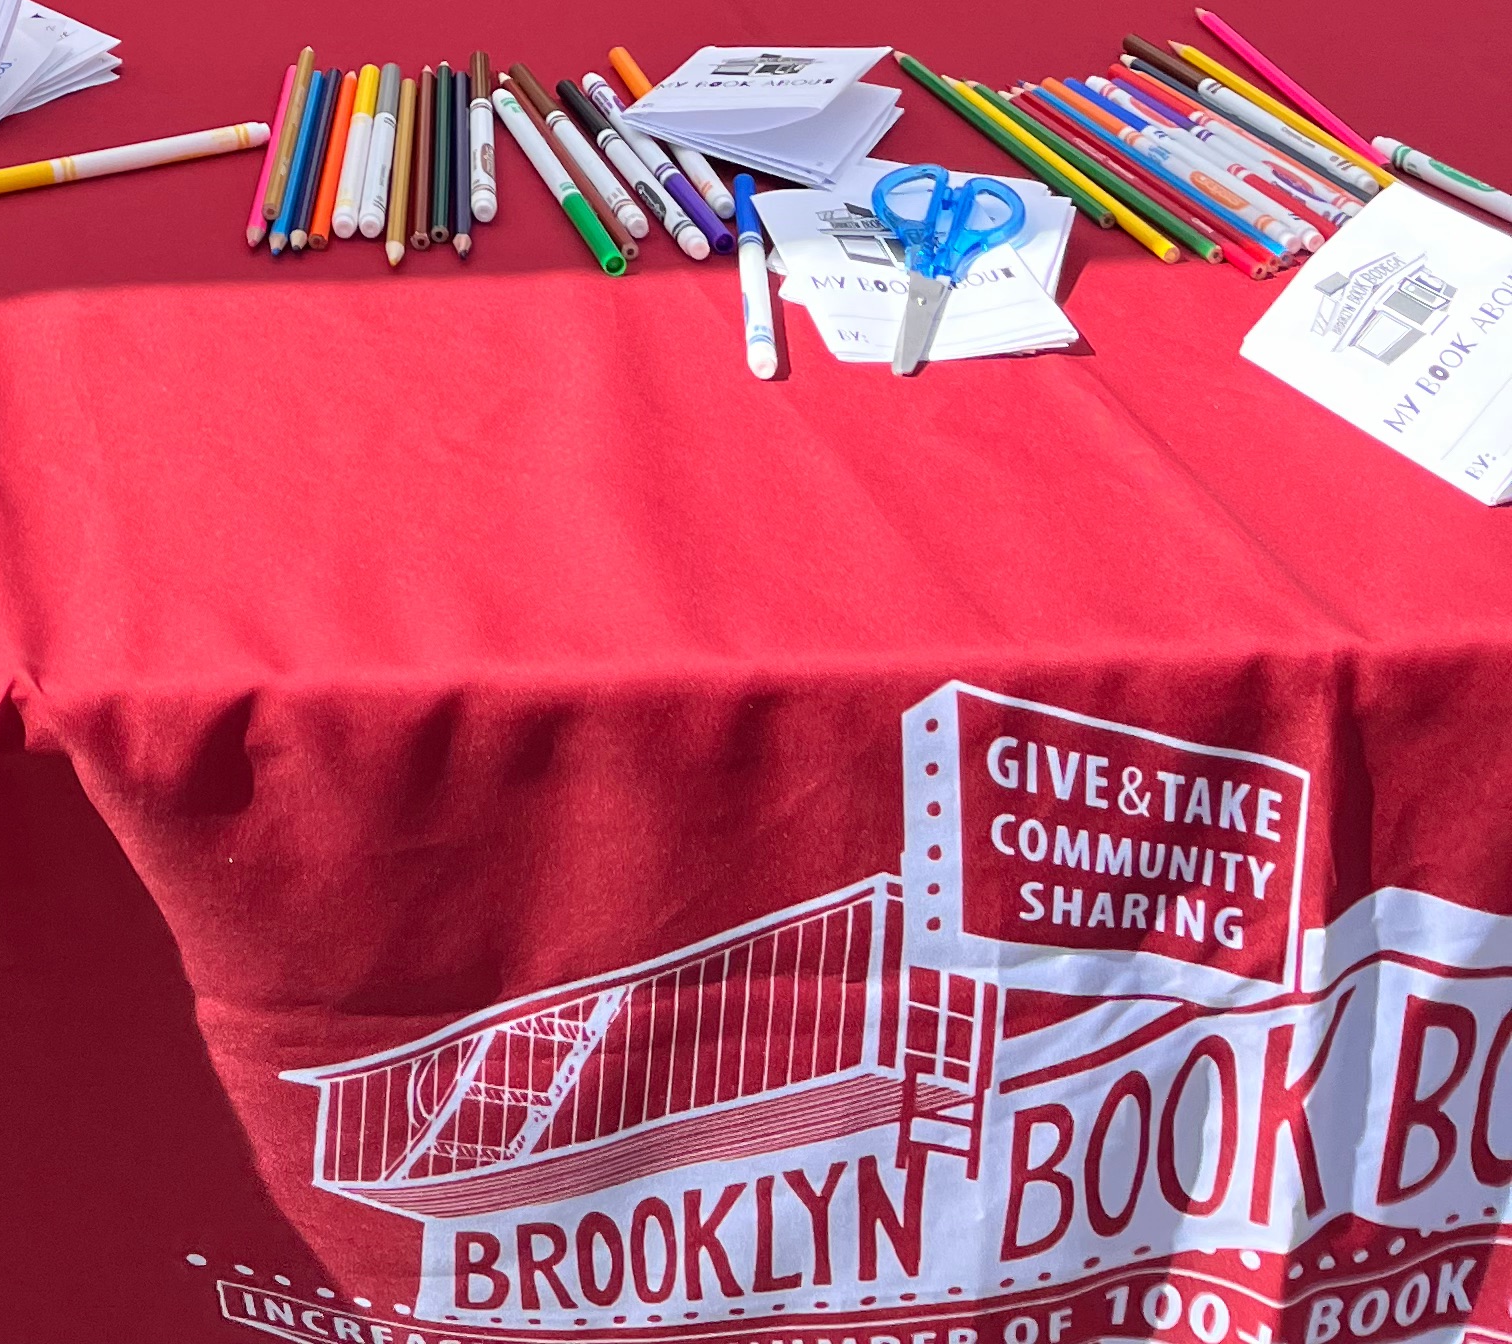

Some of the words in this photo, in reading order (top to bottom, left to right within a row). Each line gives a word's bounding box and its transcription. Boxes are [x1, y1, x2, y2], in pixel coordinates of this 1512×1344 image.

[810, 275, 845, 290] MY
[857, 277, 909, 295] BOO
[1346, 279, 1371, 305] BOOK
[1360, 256, 1406, 287] BODEGA
[838, 329, 869, 344] BY:
[1383, 394, 1420, 433] MY
[1415, 331, 1478, 396] BOOK
[1464, 453, 1497, 480] BY:
[990, 812, 1276, 900] COMMUNITY
[1019, 882, 1245, 950] SHARING
[454, 1144, 932, 1311] BROOKLYN
[999, 985, 1356, 1262] BOOK
[1003, 1309, 1072, 1344] OF
[1304, 1258, 1477, 1344] BOOK
